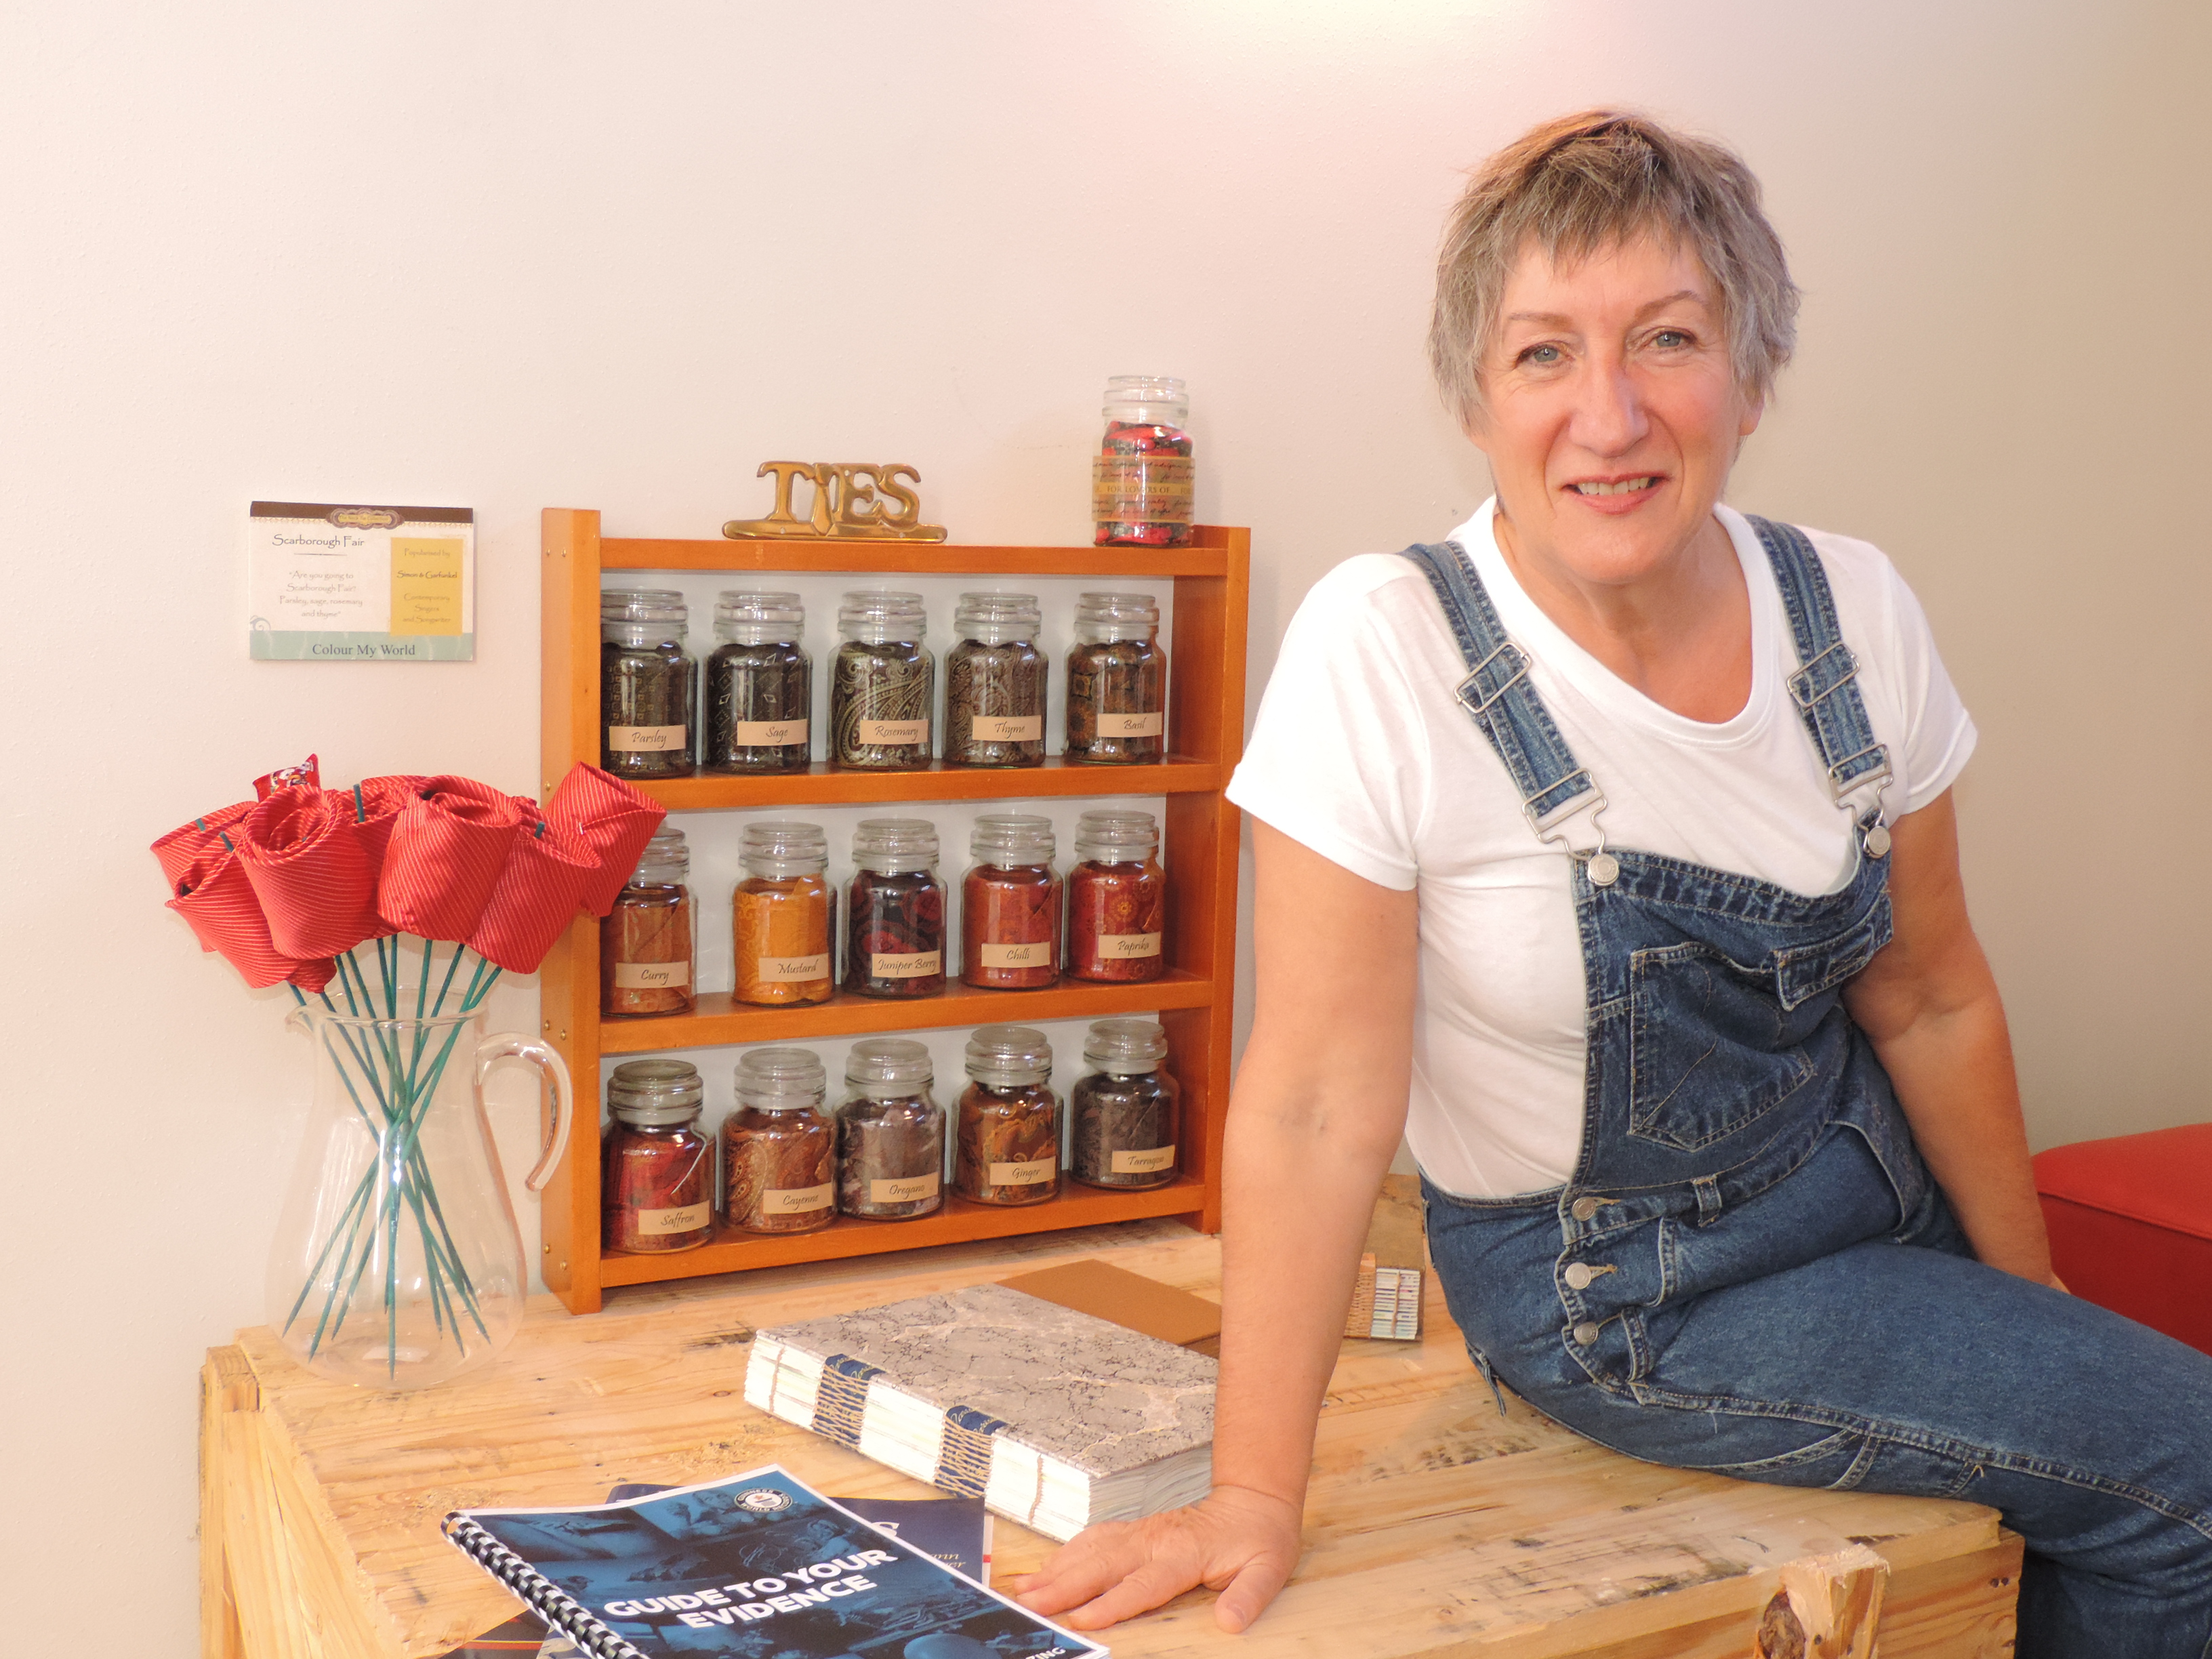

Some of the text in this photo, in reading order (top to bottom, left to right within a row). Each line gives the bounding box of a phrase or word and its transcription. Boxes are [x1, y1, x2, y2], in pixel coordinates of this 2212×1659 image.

[756, 461, 922, 532] TIES
[1125, 486, 1157, 494] LOVRS
[272, 534, 365, 549] Scarborough Fair
[442, 549, 451, 558] by
[324, 573, 345, 581] going
[396, 570, 418, 579] Simon
[425, 571, 457, 579] Garfunkel
[286, 583, 356, 594] Scarborough Fair?
[329, 598, 363, 608] rosemary
[301, 609, 316, 617] and
[312, 644, 415, 658] Colour My World
[994, 722, 1025, 740] Thyme
[1124, 718, 1147, 730] Basil
[632, 731, 668, 749] Parsley
[765, 726, 789, 743] Sage
[874, 725, 919, 741] Rosemary
[1006, 948, 1031, 961] Chilli
[1118, 941, 1150, 954] Paprika
[778, 958, 819, 974] Mustard
[878, 959, 937, 975] Juniper Berry
[640, 969, 670, 986] Curry
[1128, 1155, 1164, 1170] Tarragon
[1012, 1167, 1041, 1183] Ginger
[889, 1183, 926, 1200] Oregano
[783, 1194, 819, 1210] Cayenne
[660, 1212, 695, 1228] Saffron
[603, 1549, 899, 1617] GUIDE TO YOUR
[676, 1574, 878, 1629] EVIDENCE
